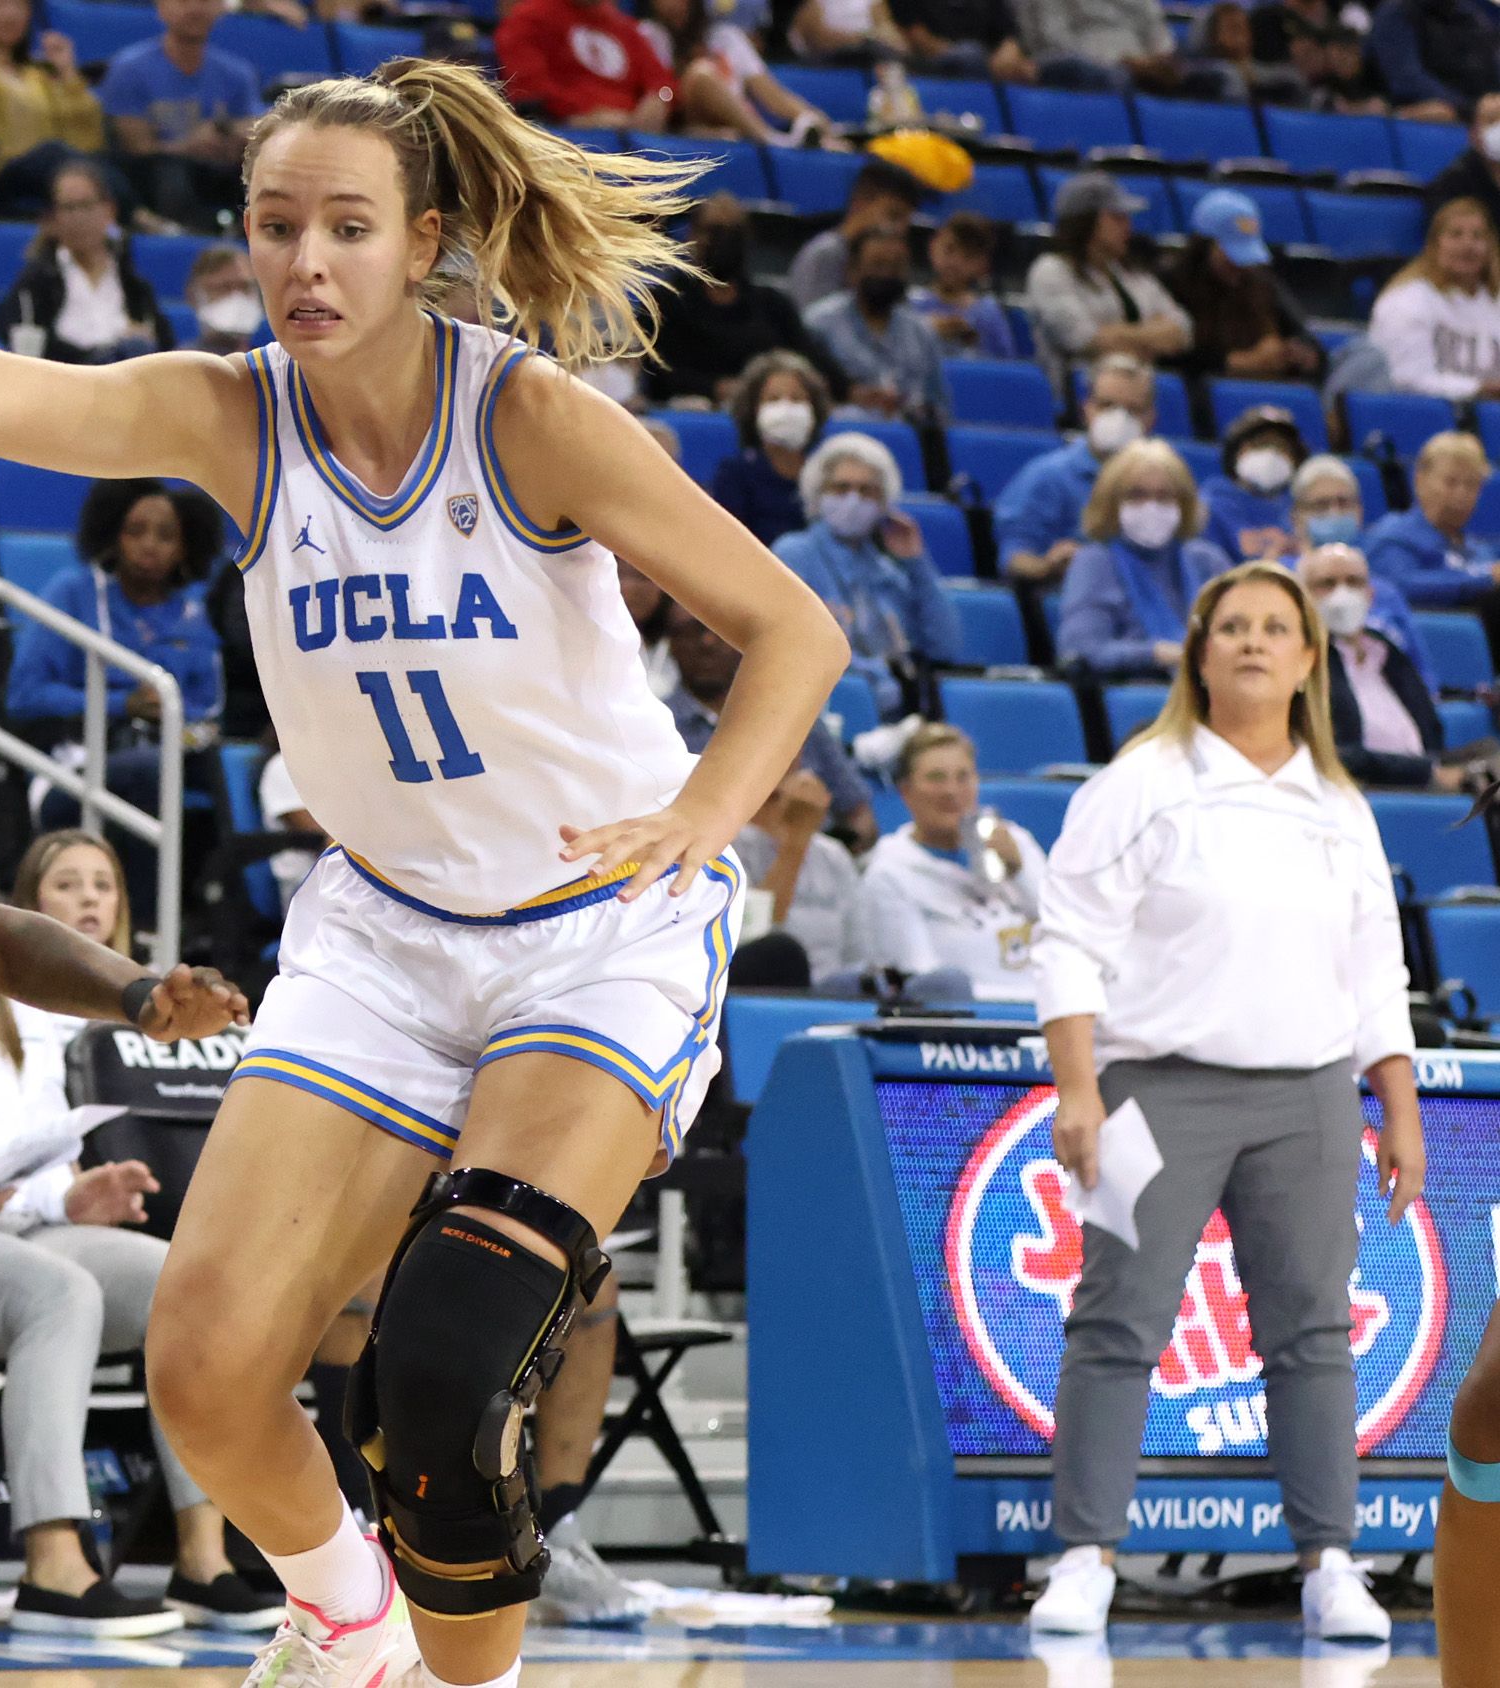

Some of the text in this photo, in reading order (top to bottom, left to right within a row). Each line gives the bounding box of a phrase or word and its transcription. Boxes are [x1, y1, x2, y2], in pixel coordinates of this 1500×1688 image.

[289, 573, 518, 652] UCLA
[355, 670, 485, 783] 11
[1390, 1494, 1425, 1537] by
